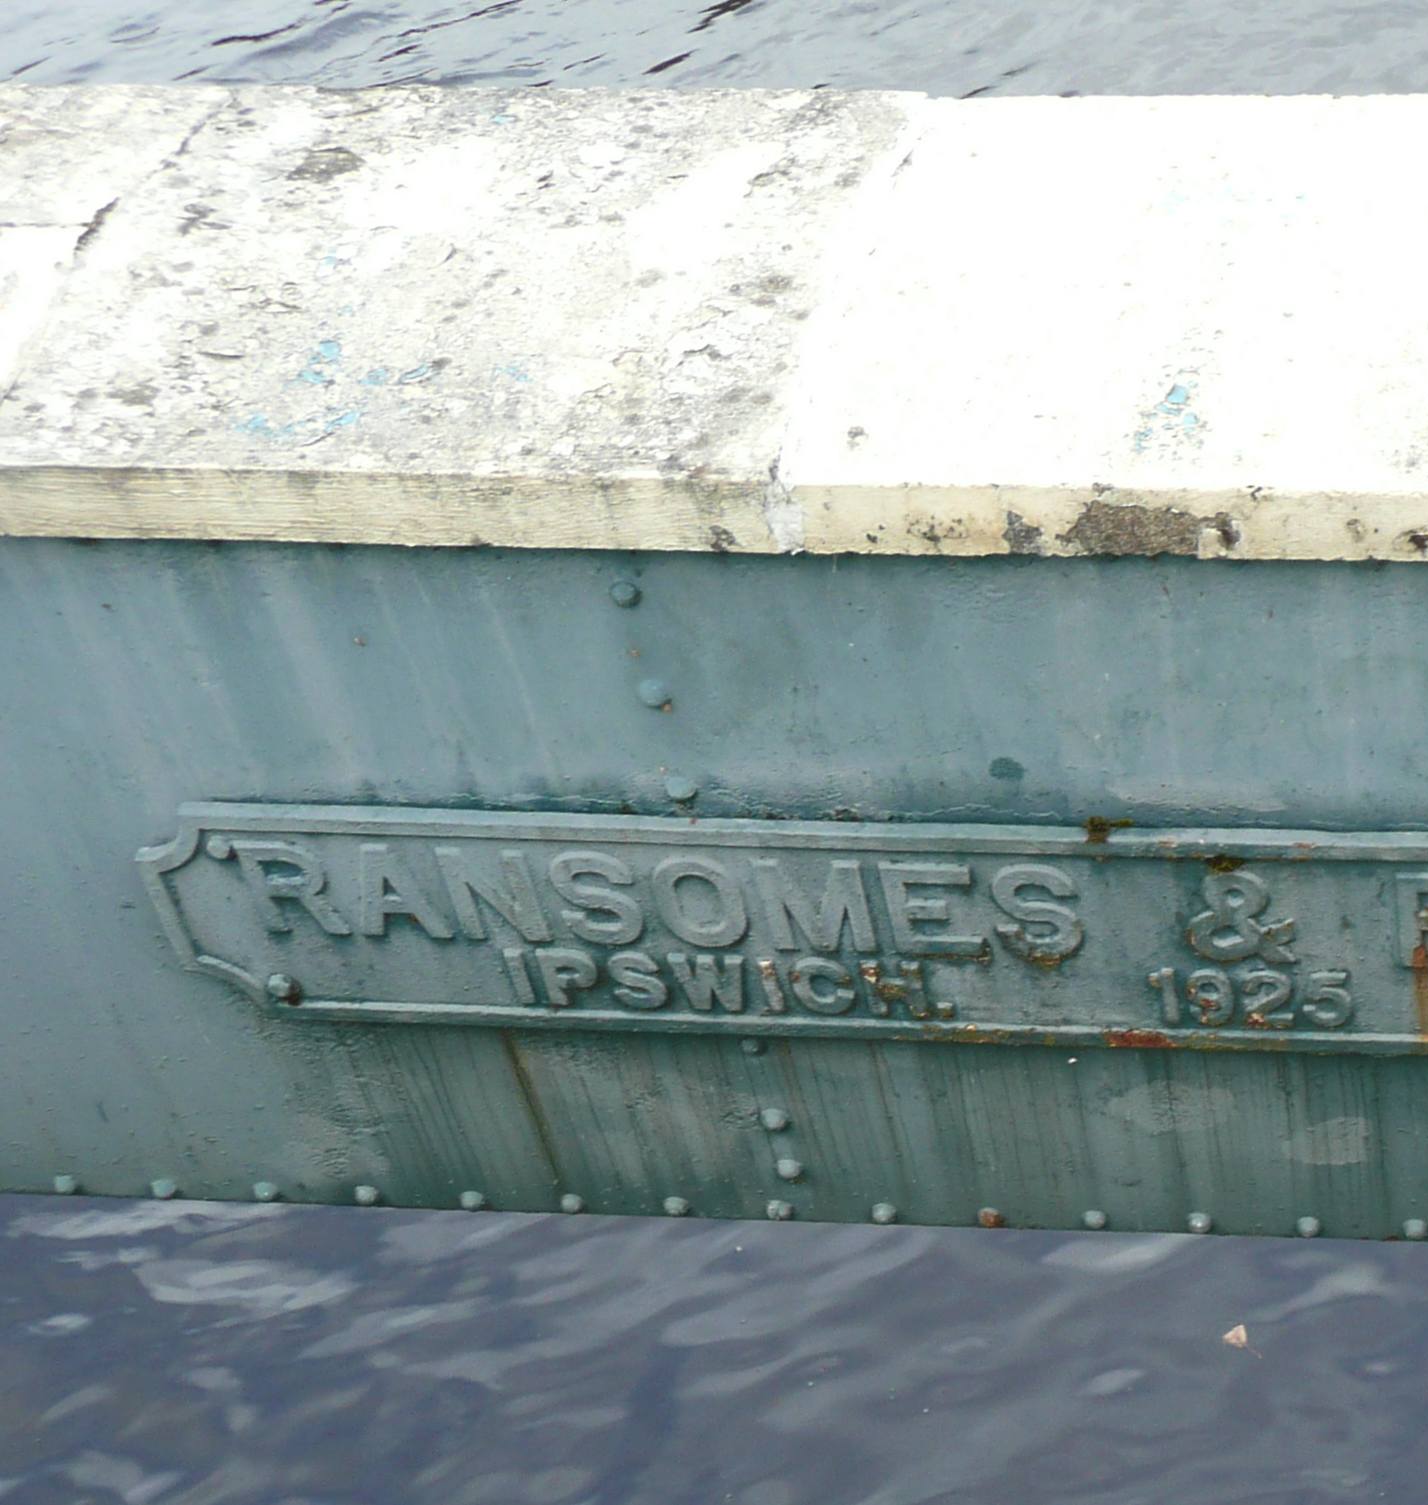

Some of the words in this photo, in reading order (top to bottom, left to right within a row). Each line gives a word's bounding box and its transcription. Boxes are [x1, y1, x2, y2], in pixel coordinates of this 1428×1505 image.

[236, 838, 1084, 965] RANSOMES
[1190, 871, 1298, 962] &
[1148, 967, 1354, 1028] 1925
